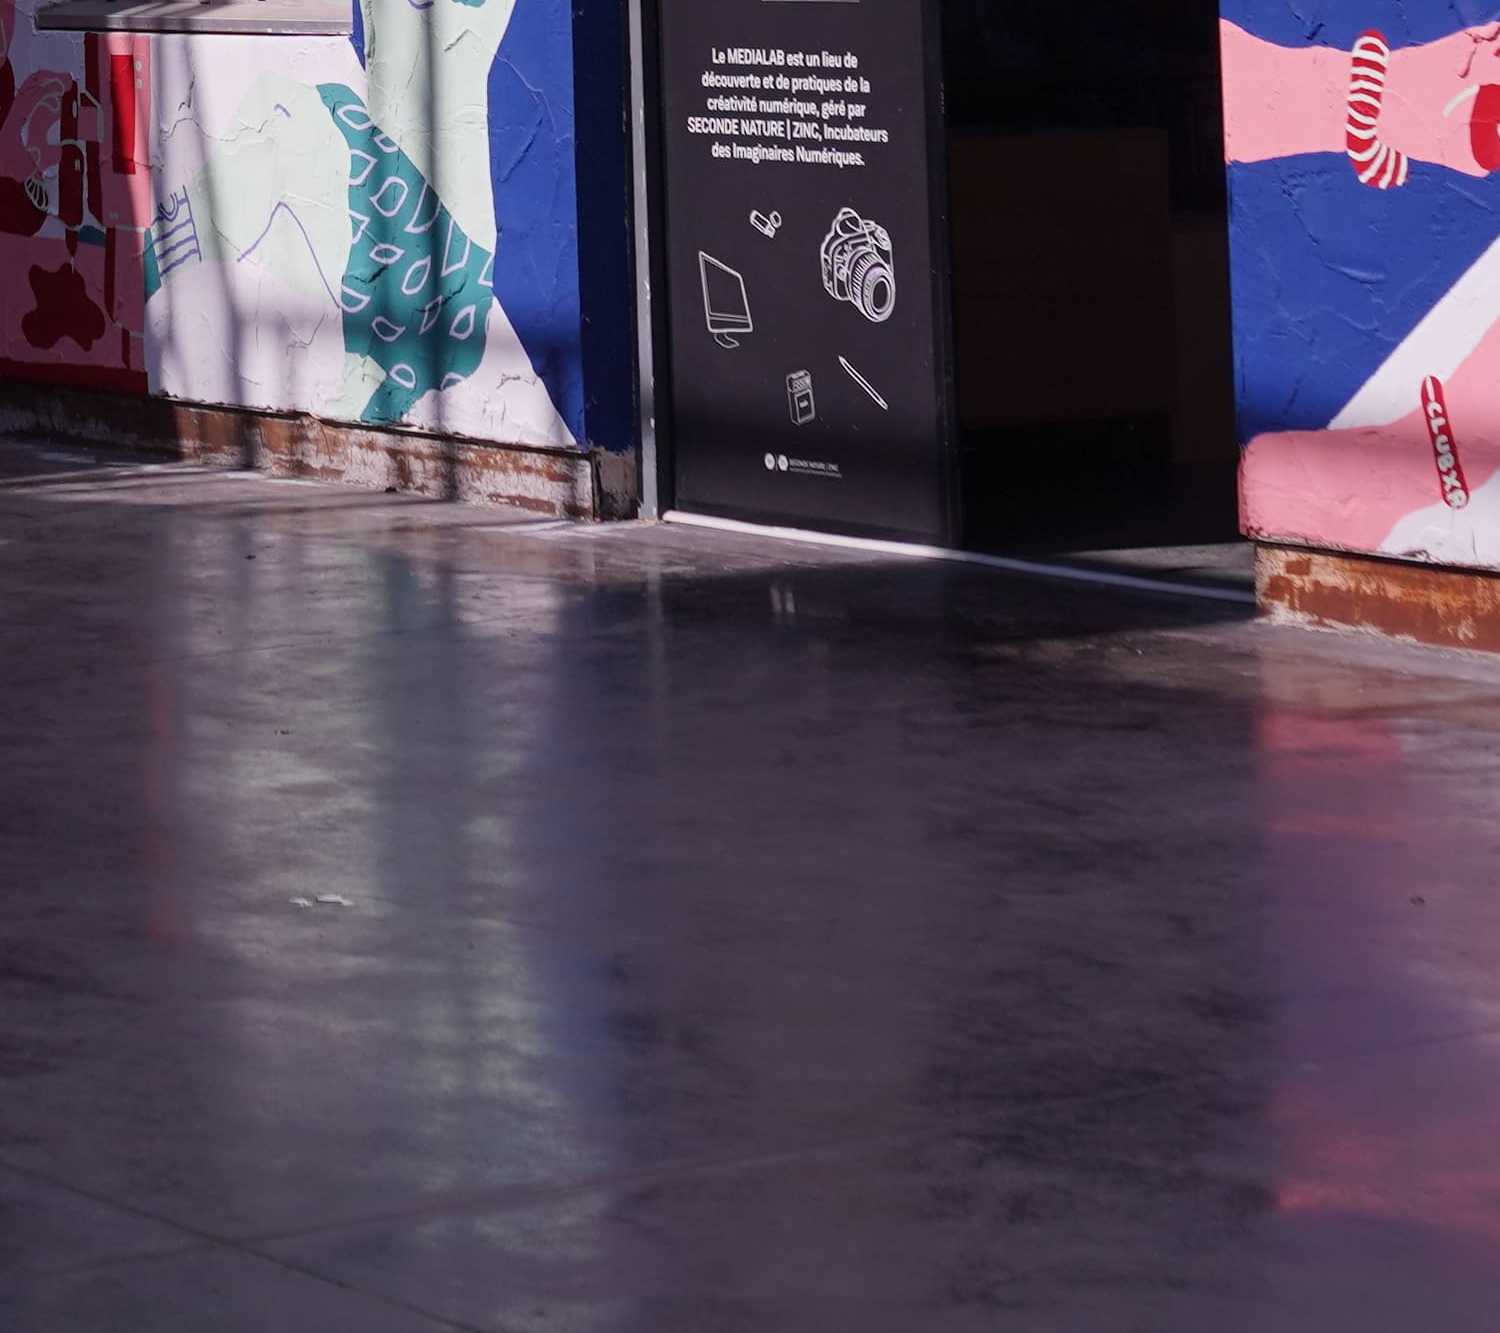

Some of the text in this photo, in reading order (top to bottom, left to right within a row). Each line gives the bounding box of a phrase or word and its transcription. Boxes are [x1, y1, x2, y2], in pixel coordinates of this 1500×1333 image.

[712, 48, 858, 69] Le MEDIALAB est un lieu de
[701, 71, 871, 95] découverte et de pratiques de la
[707, 94, 867, 120] créativité numérique, géré par
[687, 116, 740, 135] SECONDE
[740, 118, 785, 137] NATURE
[792, 121, 822, 142] ZINC,
[823, 124, 889, 143] Incubateurs
[712, 142, 866, 168] des Imaginaires Numériques.
